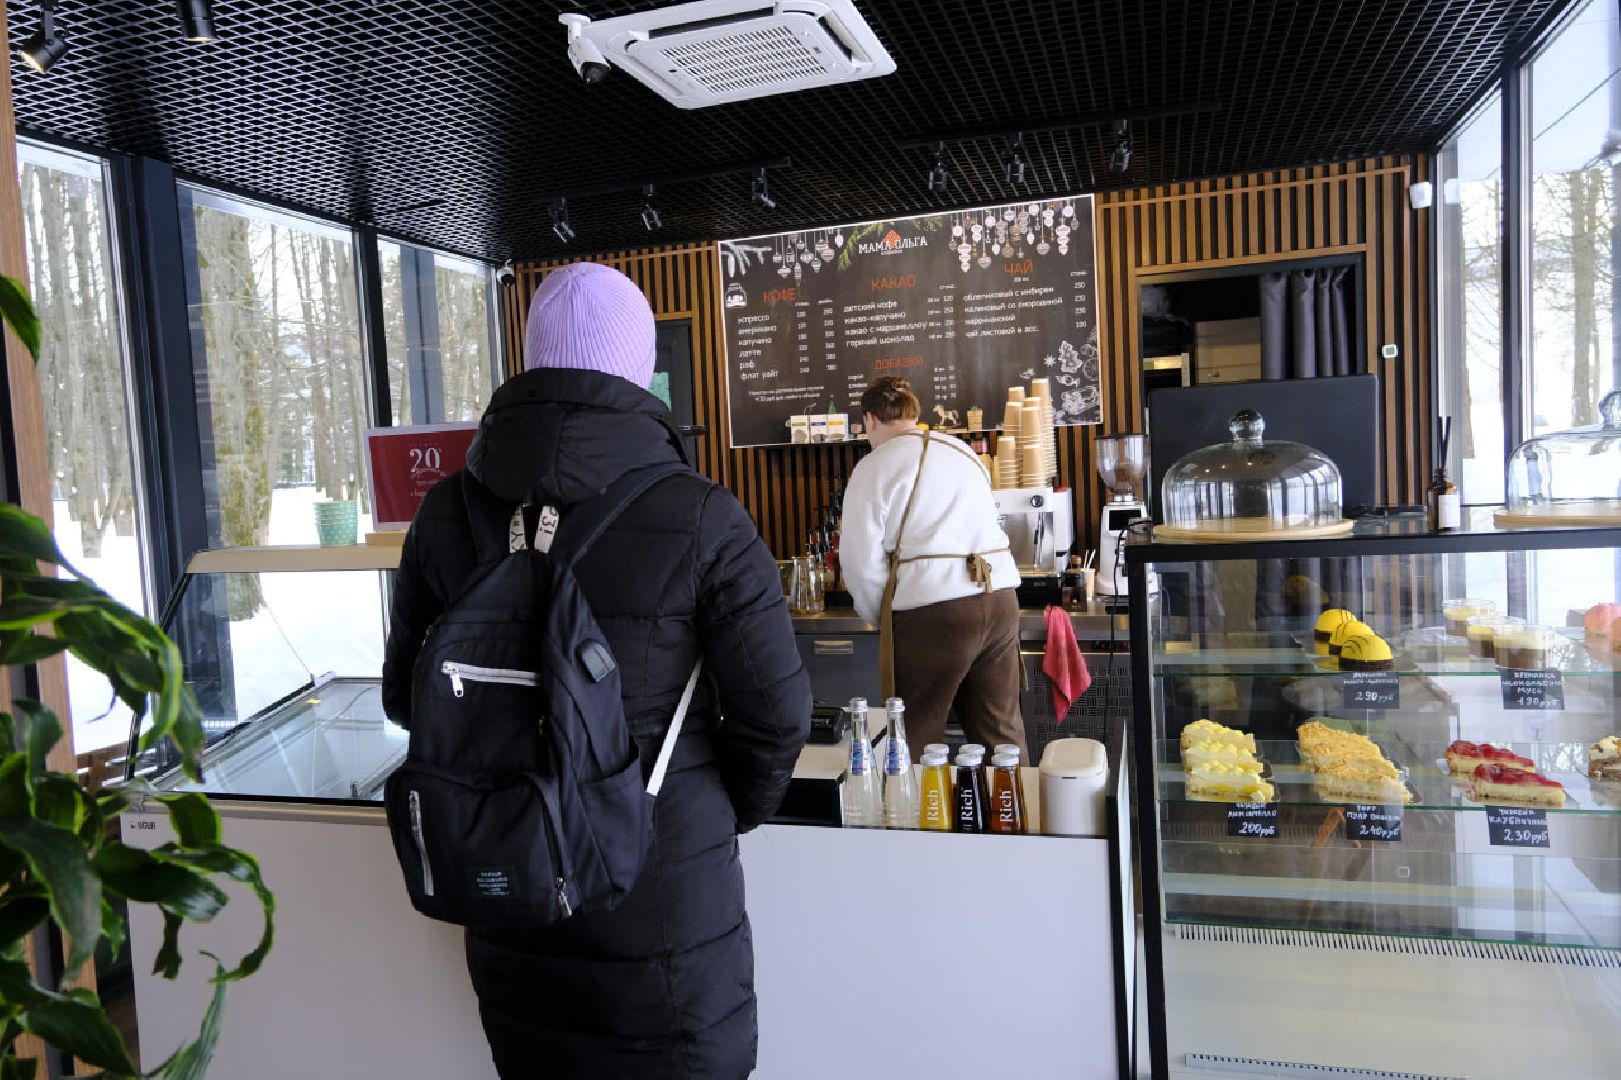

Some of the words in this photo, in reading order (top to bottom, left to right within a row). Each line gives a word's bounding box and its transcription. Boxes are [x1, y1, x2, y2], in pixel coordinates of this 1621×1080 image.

[858, 239, 893, 254] МАМА
[895, 235, 929, 249] ОЛЬГА
[1004, 259, 1034, 278] ЧАЙ
[871, 274, 917, 291] КАКАО
[763, 287, 796, 304] КОФЕ
[927, 789, 940, 821] Rich
[960, 789, 974, 821] Rich
[999, 790, 1014, 823] Rich
